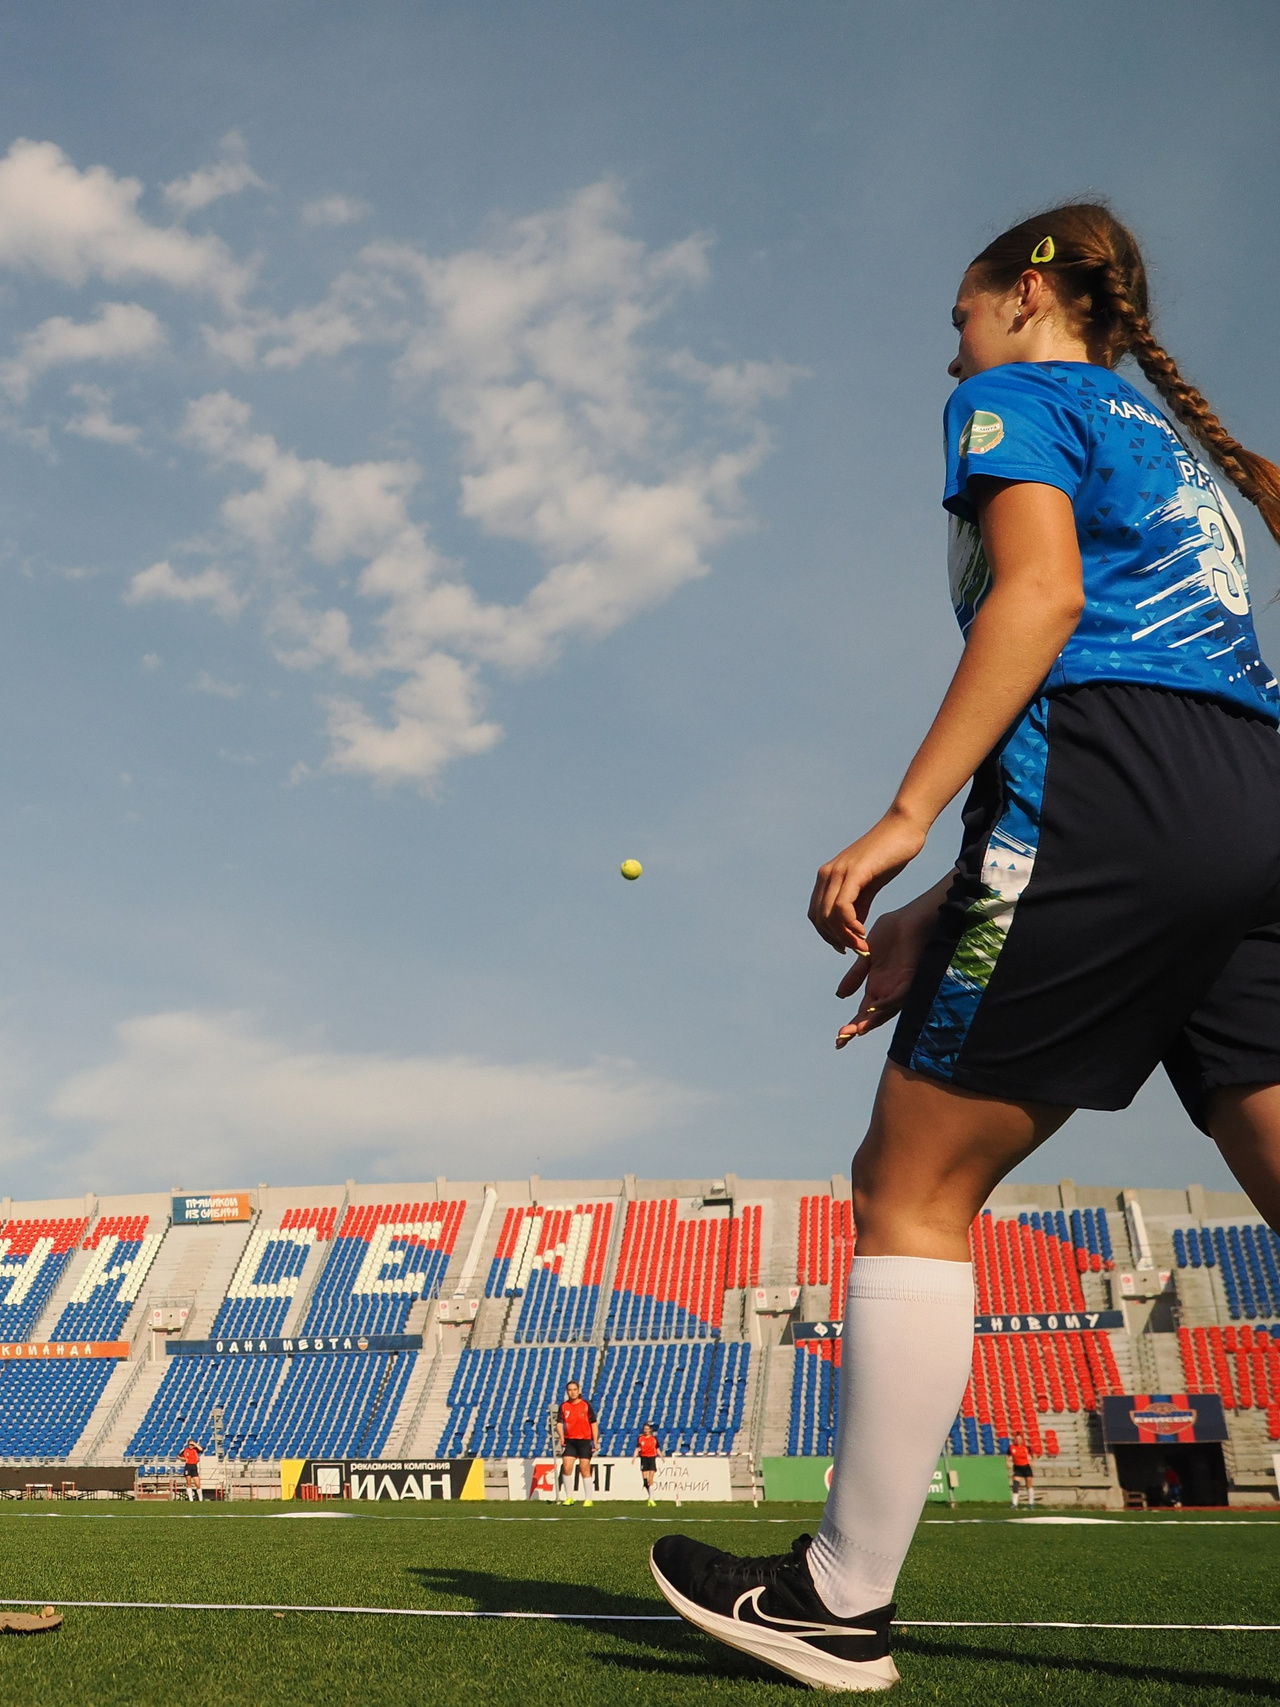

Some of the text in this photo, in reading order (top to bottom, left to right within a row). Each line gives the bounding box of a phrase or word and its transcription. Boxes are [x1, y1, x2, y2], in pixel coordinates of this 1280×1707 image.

[185, 1197, 238, 1209] ПРЯМИКОМ
[185, 1207, 239, 1219] ИЗ СИБИРИ
[1, 1343, 92, 1356] КОМАНДА
[216, 1340, 267, 1353] ОДНА
[350, 1462, 450, 1471] рекламная компания
[350, 1474, 452, 1500] ИЛАН
